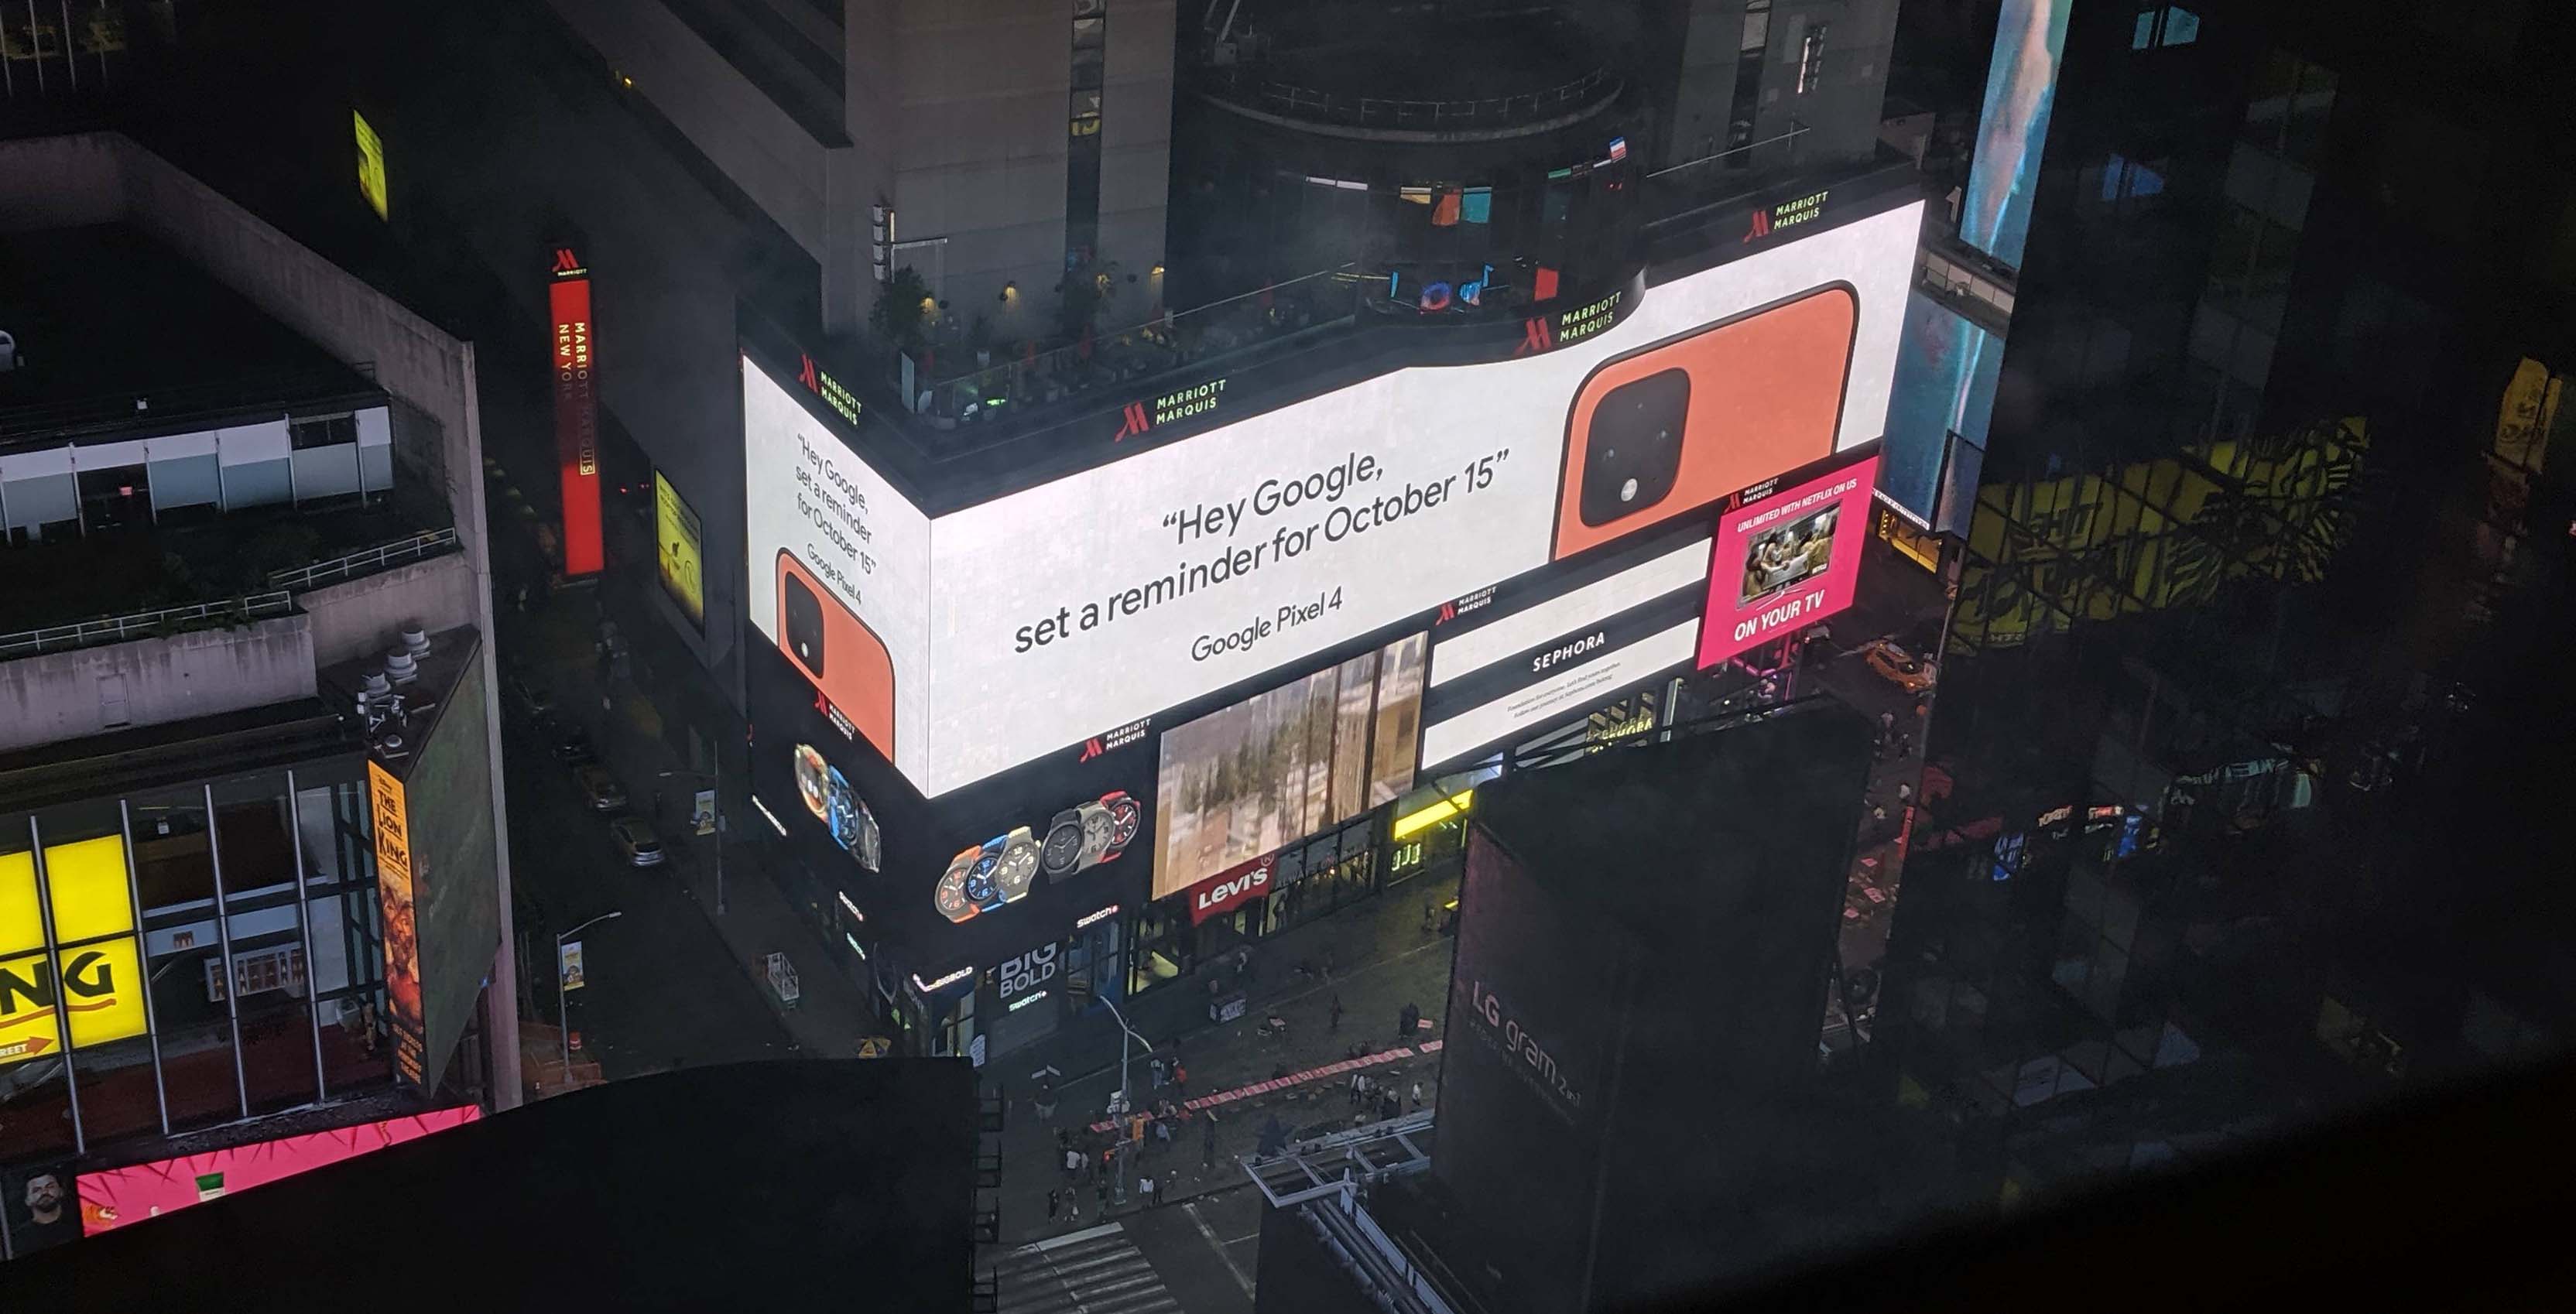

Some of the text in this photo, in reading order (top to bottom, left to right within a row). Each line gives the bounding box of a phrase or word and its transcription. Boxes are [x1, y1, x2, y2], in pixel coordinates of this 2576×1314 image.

[1774, 207, 1820, 230] MARQUIS
[1776, 191, 1828, 216] MARRIOTT
[1562, 291, 1622, 326] MARRIOTT
[558, 323, 571, 357] NEW
[1560, 312, 1613, 342] MARQUIS
[821, 371, 862, 413] MARRIOTT
[821, 387, 858, 425] MARQUIS
[1156, 379, 1226, 410] MARRIOTT
[1156, 397, 1217, 425] MARQUIS
[825, 460, 868, 515] Google,
[1253, 452, 1383, 517] Google,
[1742, 488, 1773, 505] MARQUIS
[1744, 477, 1780, 496] MARRIOTT
[796, 466, 872, 544] set a reminder
[1737, 478, 1857, 534] UNLIMITED WITH NETFLIX ON US
[797, 492, 813, 518] for
[814, 508, 858, 562] October
[807, 543, 862, 605] Google Pixel 4
[1015, 607, 1070, 654] set
[1080, 603, 1099, 631] a
[1108, 542, 1267, 621] reminder
[1273, 523, 1320, 564] for
[1324, 476, 1457, 542] October
[1458, 586, 1497, 606] MARRIOTT
[1458, 596, 1491, 615] MARQUIS
[1191, 586, 1343, 662] Google Pixel 4
[1734, 590, 1825, 642] ON YOUR TV
[1533, 631, 1605, 672] SEPHORA
[1106, 730, 1146, 751] MARQUIS
[1107, 718, 1152, 741] MARRIOTT
[378, 789, 396, 813] THE
[377, 803, 402, 837] LION
[378, 826, 408, 867] KING
[1077, 907, 1112, 929] swatch
[999, 961, 1056, 999] BOLD
[1472, 980, 1500, 1028] LG
[1506, 1019, 1556, 1085] gram
